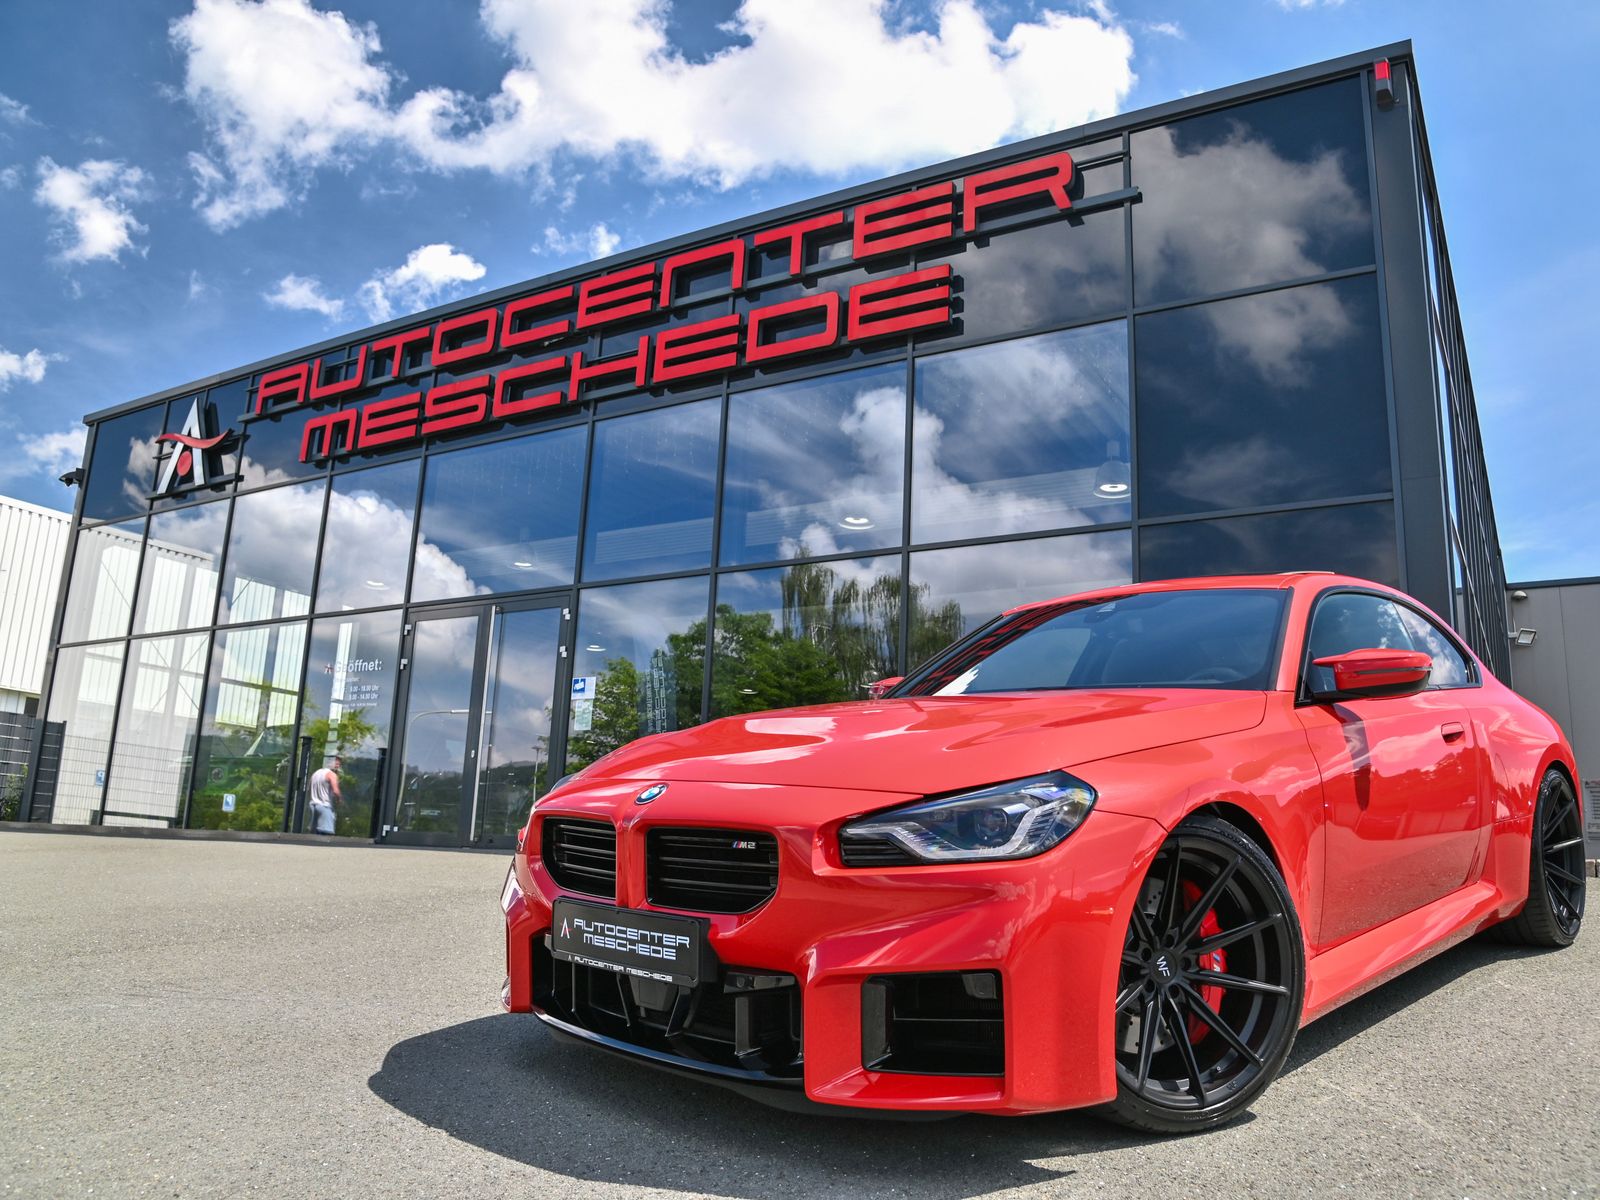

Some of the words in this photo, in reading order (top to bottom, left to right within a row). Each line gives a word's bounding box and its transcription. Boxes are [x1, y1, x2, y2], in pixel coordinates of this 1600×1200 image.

[253, 150, 1075, 416] AUTOCENTER
[298, 262, 954, 463] MESCHEDE
[573, 918, 690, 948] AUTOCENTER
[583, 932, 677, 960] MESCHEDE
[574, 956, 625, 973] AUTOCENTER
[626, 967, 673, 982] MESCHEDE
